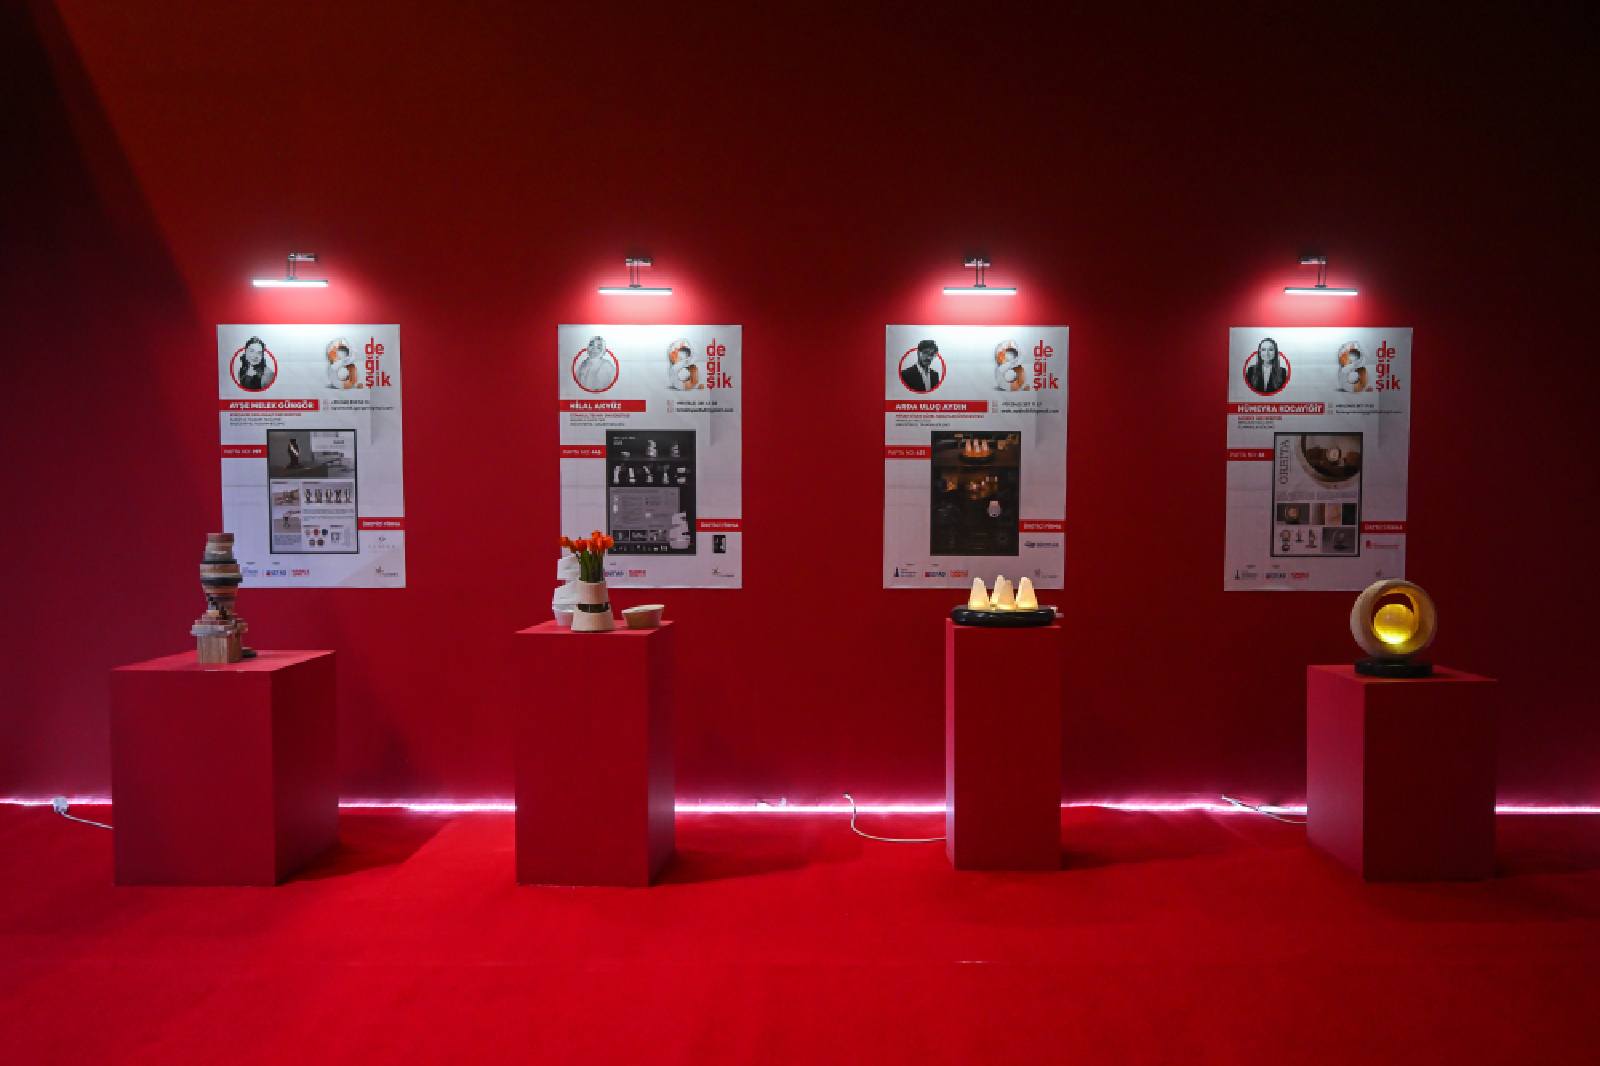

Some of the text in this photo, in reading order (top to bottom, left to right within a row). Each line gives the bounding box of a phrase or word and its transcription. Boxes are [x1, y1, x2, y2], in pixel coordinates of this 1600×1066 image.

[364, 336, 385, 355] de
[706, 338, 726, 357] de
[1033, 340, 1054, 358] de
[1376, 340, 1396, 359] de
[364, 371, 393, 389] şik
[706, 372, 734, 390] şik
[1033, 373, 1059, 391] şik
[1376, 375, 1401, 392] şik
